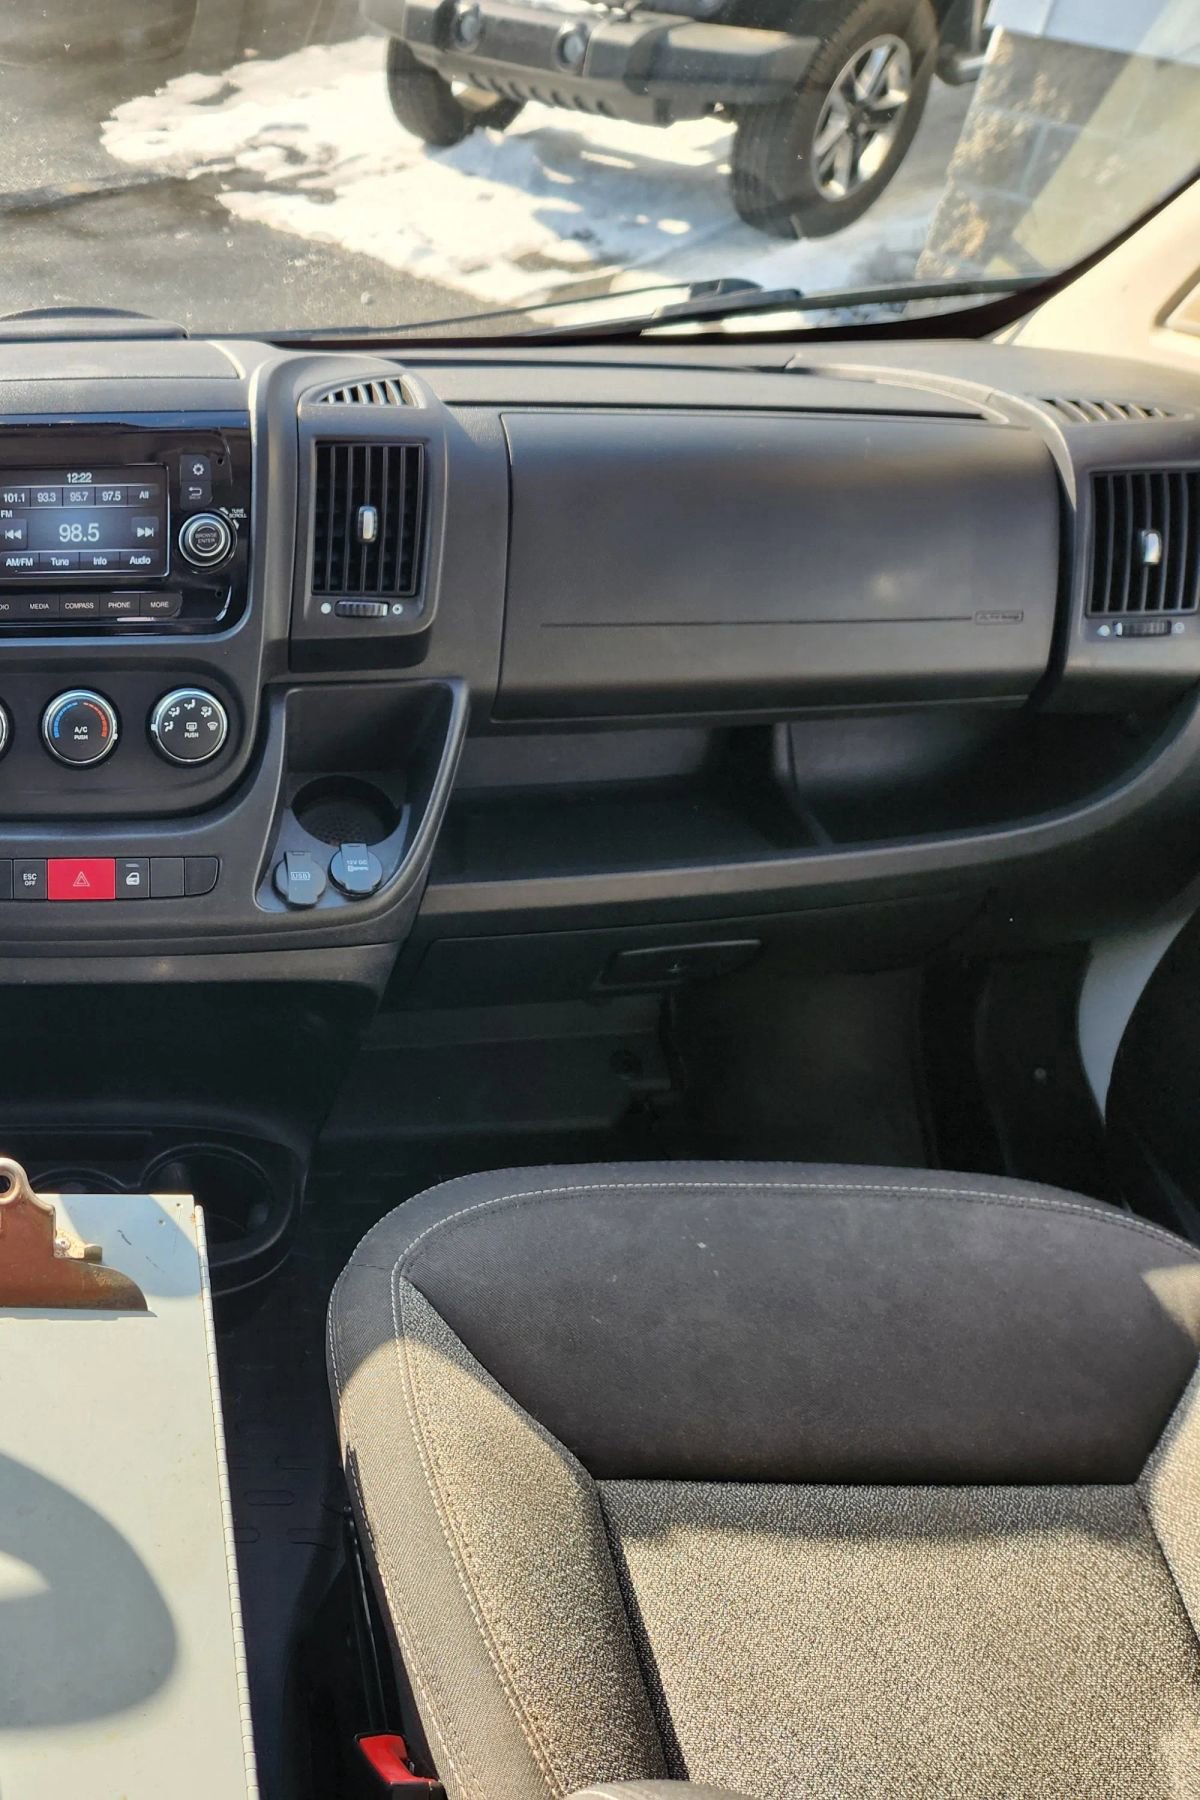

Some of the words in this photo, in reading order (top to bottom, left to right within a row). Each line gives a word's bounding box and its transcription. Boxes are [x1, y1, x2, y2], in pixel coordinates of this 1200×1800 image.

[66, 472, 92, 484] 12:22
[3, 493, 25, 503] 101.1
[37, 492, 57, 502] 93.3
[69, 492, 89, 502] 95.7
[102, 491, 122, 501] 97.5
[0, 510, 13, 518] FM
[59, 523, 100, 542] 98.5
[5, 557, 33, 566] AM/FM
[50, 557, 70, 566] Tune
[93, 555, 108, 565] Info
[129, 555, 152, 565] Audio
[64, 602, 95, 610] COMPASS
[108, 601, 131, 609] PHONE
[150, 601, 170, 609] MORE
[74, 726, 88, 734] A/C
[23, 873, 37, 881] ESC
[291, 872, 310, 880] USB
